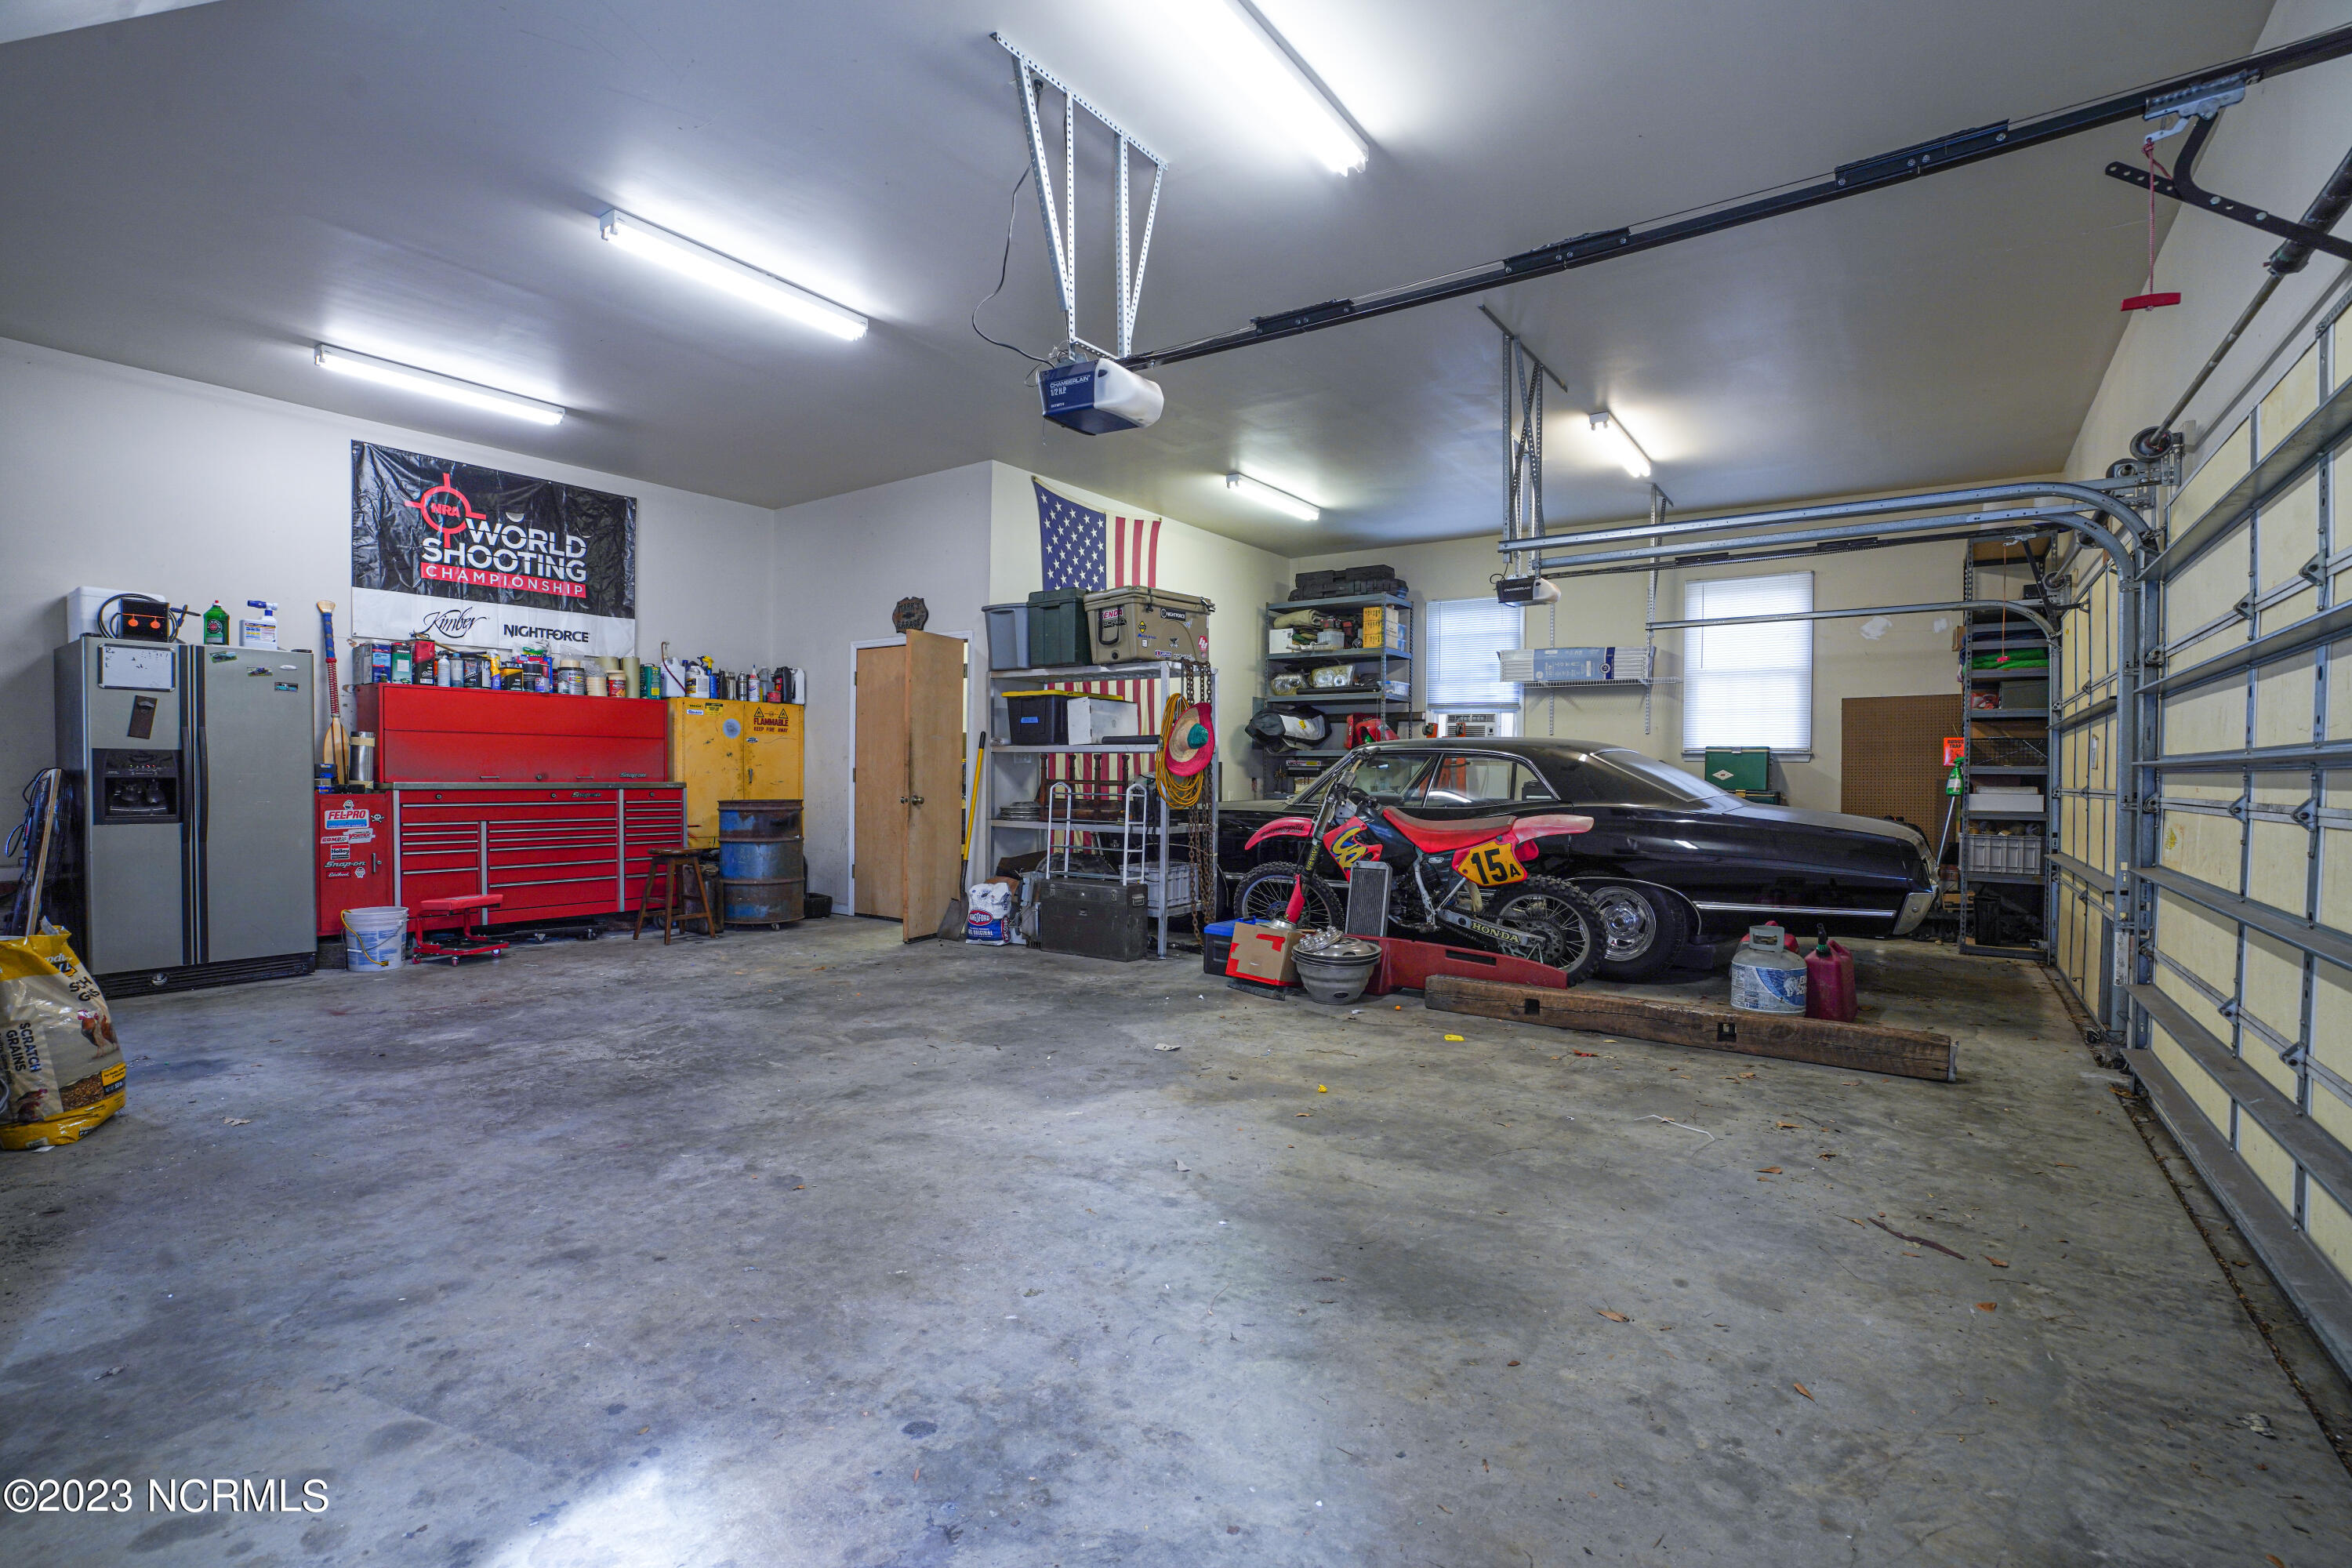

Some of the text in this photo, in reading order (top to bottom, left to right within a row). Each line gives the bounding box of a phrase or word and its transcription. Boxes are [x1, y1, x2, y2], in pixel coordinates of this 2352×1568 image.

[1050, 375, 1091, 388] CHAMBERLAIN
[430, 503, 460, 517] NRA
[466, 518, 586, 559] WORLD
[422, 537, 586, 583] SHOOTING
[425, 565, 583, 595] CHAMPIONSHIP
[423, 607, 487, 638] Kimber
[503, 625, 589, 643] NIGHTFORCE
[753, 717, 789, 727] FLAMMABLE
[1472, 921, 1521, 945] HONDA
[6, 1029, 27, 1072] GRAINS
[19, 1022, 42, 1073] SCRATCH
